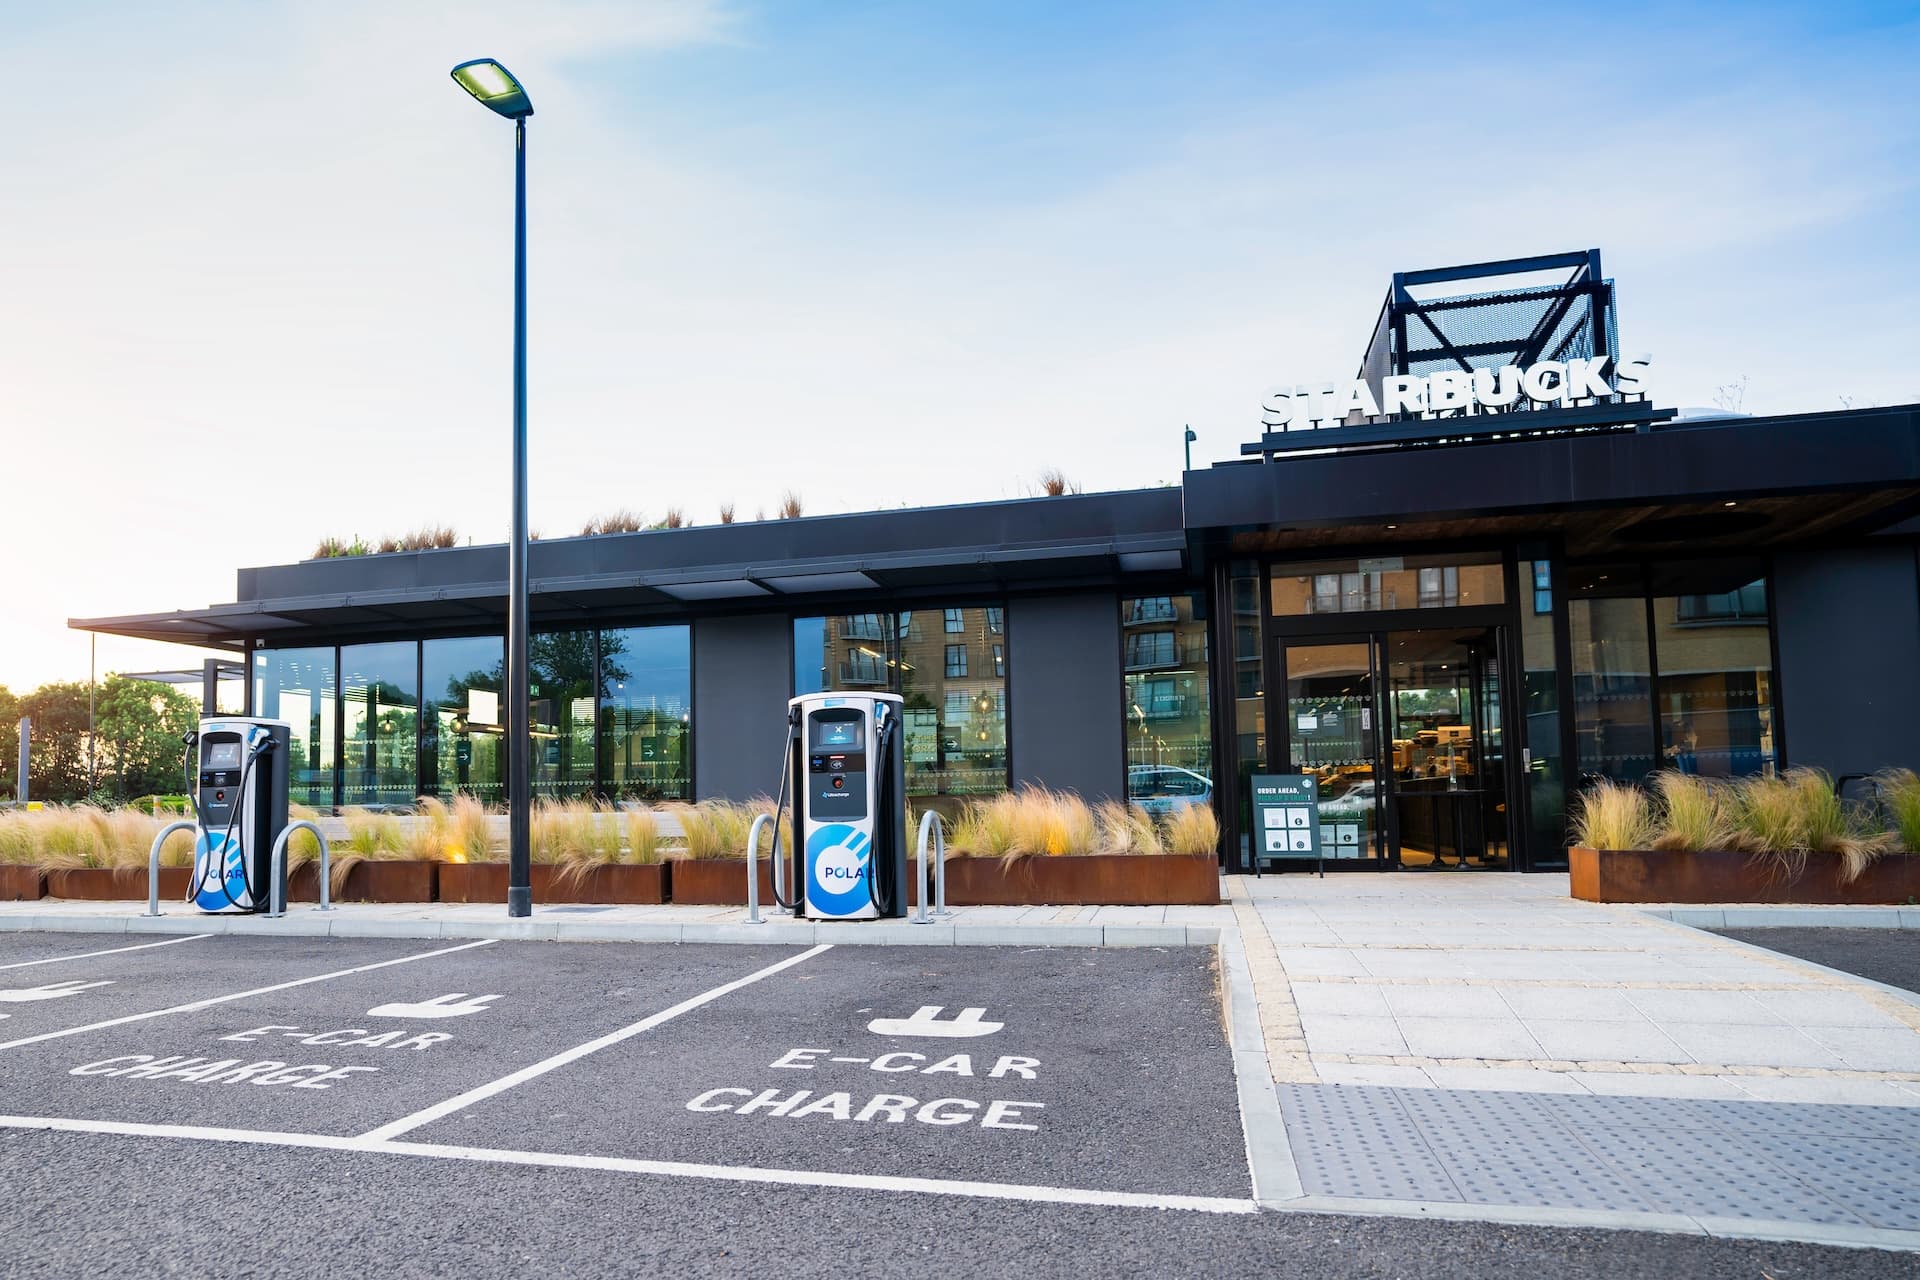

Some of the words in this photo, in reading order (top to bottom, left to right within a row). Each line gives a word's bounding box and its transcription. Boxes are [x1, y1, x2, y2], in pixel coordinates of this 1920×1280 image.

[1262, 353, 1653, 425] STARBUCKS
[218, 1026, 454, 1050] E-CAR
[69, 1055, 380, 1089] CHARGE
[769, 1048, 1041, 1079] E-CAR
[685, 1087, 1045, 1131] CHARGE
